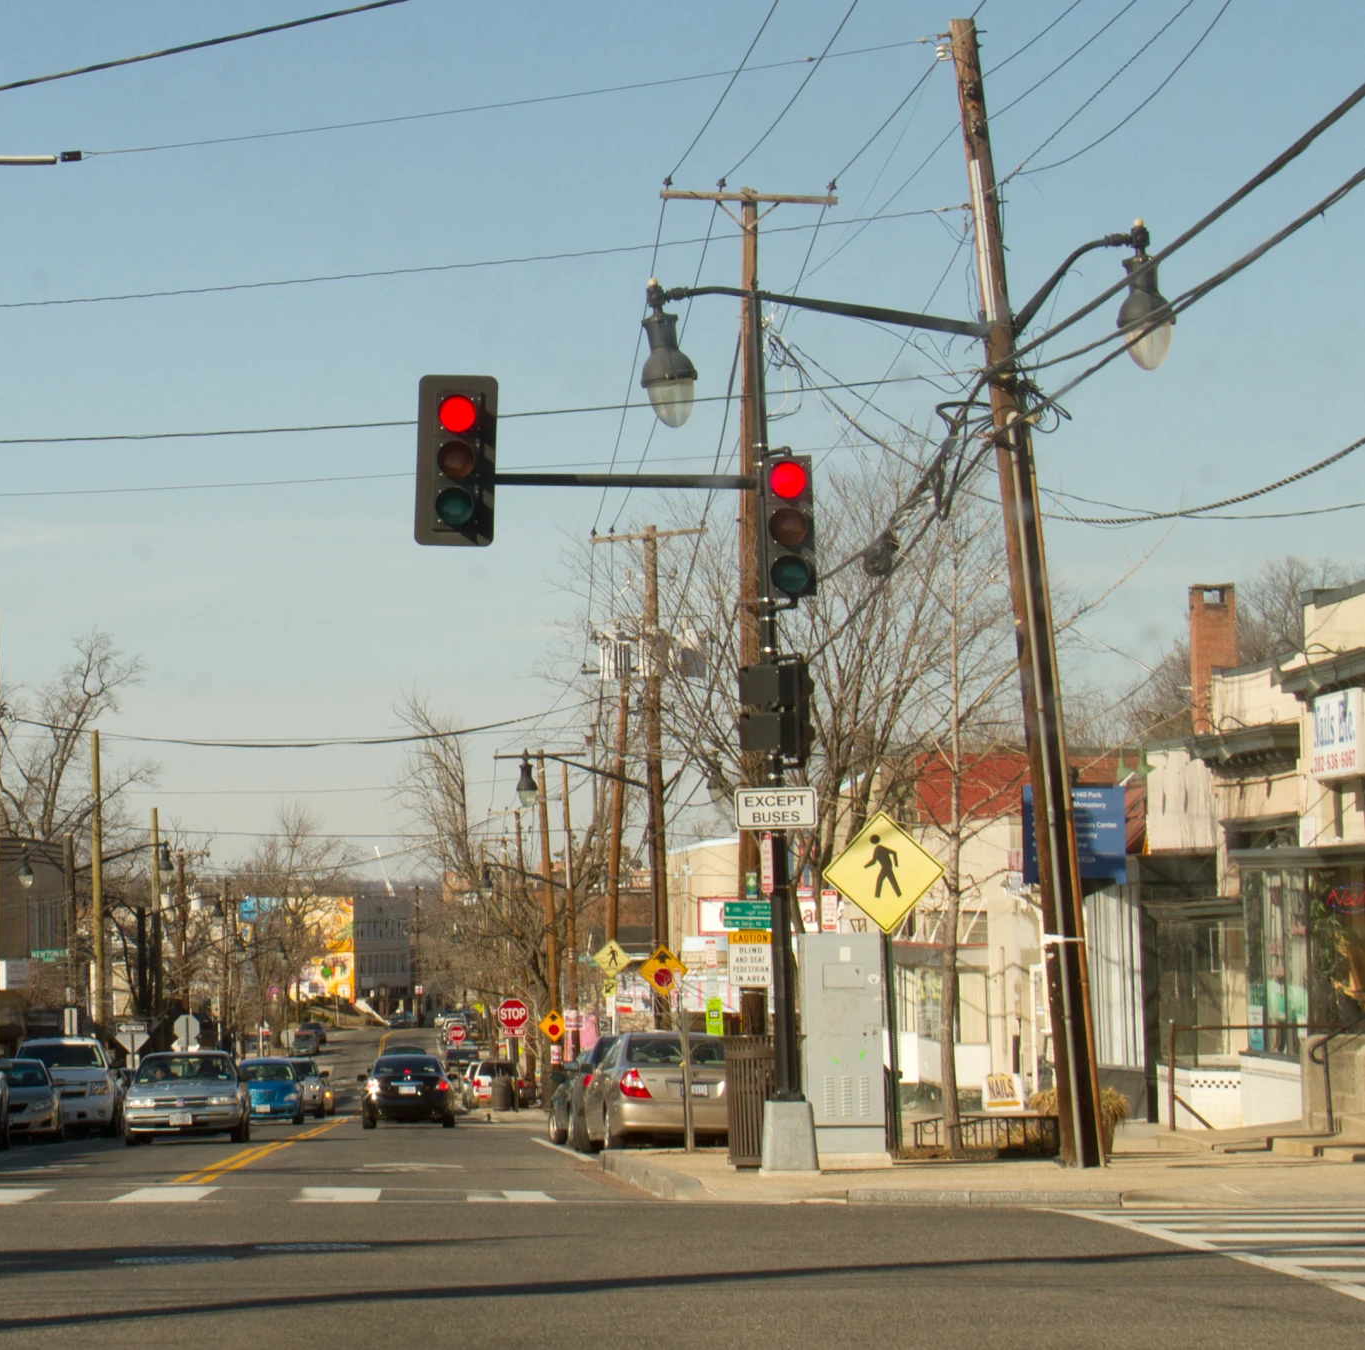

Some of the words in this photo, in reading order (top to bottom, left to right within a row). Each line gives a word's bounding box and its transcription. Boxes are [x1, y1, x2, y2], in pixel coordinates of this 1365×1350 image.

[1313, 703, 1335, 748] Nails
[744, 794, 807, 807] EXCEPT
[1073, 801, 1107, 810] Monastery
[752, 810, 801, 823] BUSES
[732, 933, 769, 943] CAUTION
[738, 946, 763, 954] BLIND
[735, 956, 749, 964] AND
[749, 956, 765, 964] DEAF
[732, 965, 770, 973] PEDESTRIAN
[735, 975, 744, 983] IN
[746, 975, 767, 983] AREA
[500, 1007, 526, 1020] STOP
[449, 1029, 464, 1038] STOP
[987, 1077, 1015, 1100] NAILS
